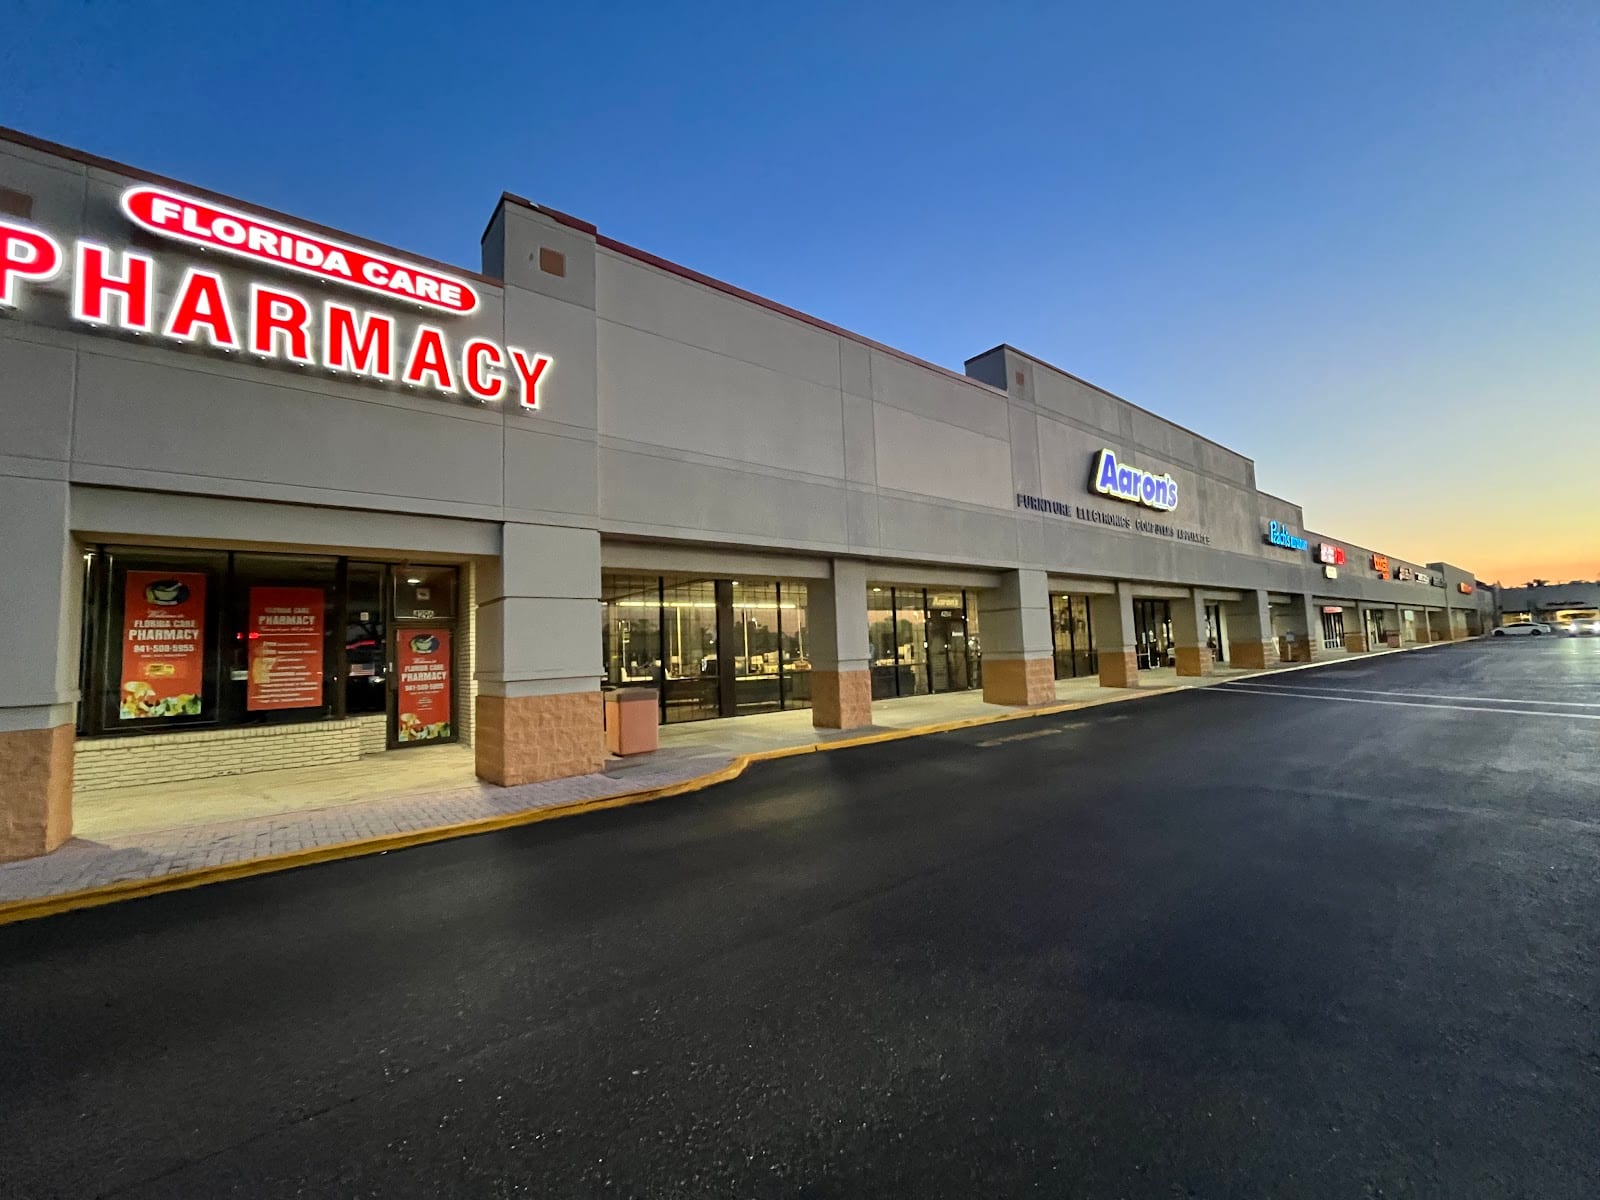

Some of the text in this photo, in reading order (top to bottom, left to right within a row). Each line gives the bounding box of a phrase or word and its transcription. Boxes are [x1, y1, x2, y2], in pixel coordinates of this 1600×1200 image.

[151, 198, 463, 305] FLORIDA CARE
[0, 222, 553, 410] PHARMACY
[1098, 450, 1178, 511] Aaron's
[1016, 493, 1072, 517] FURNITURE
[258, 616, 315, 625] PHARMACY
[128, 629, 199, 641] PHARMACY
[401, 672, 447, 682] PHARMACY
